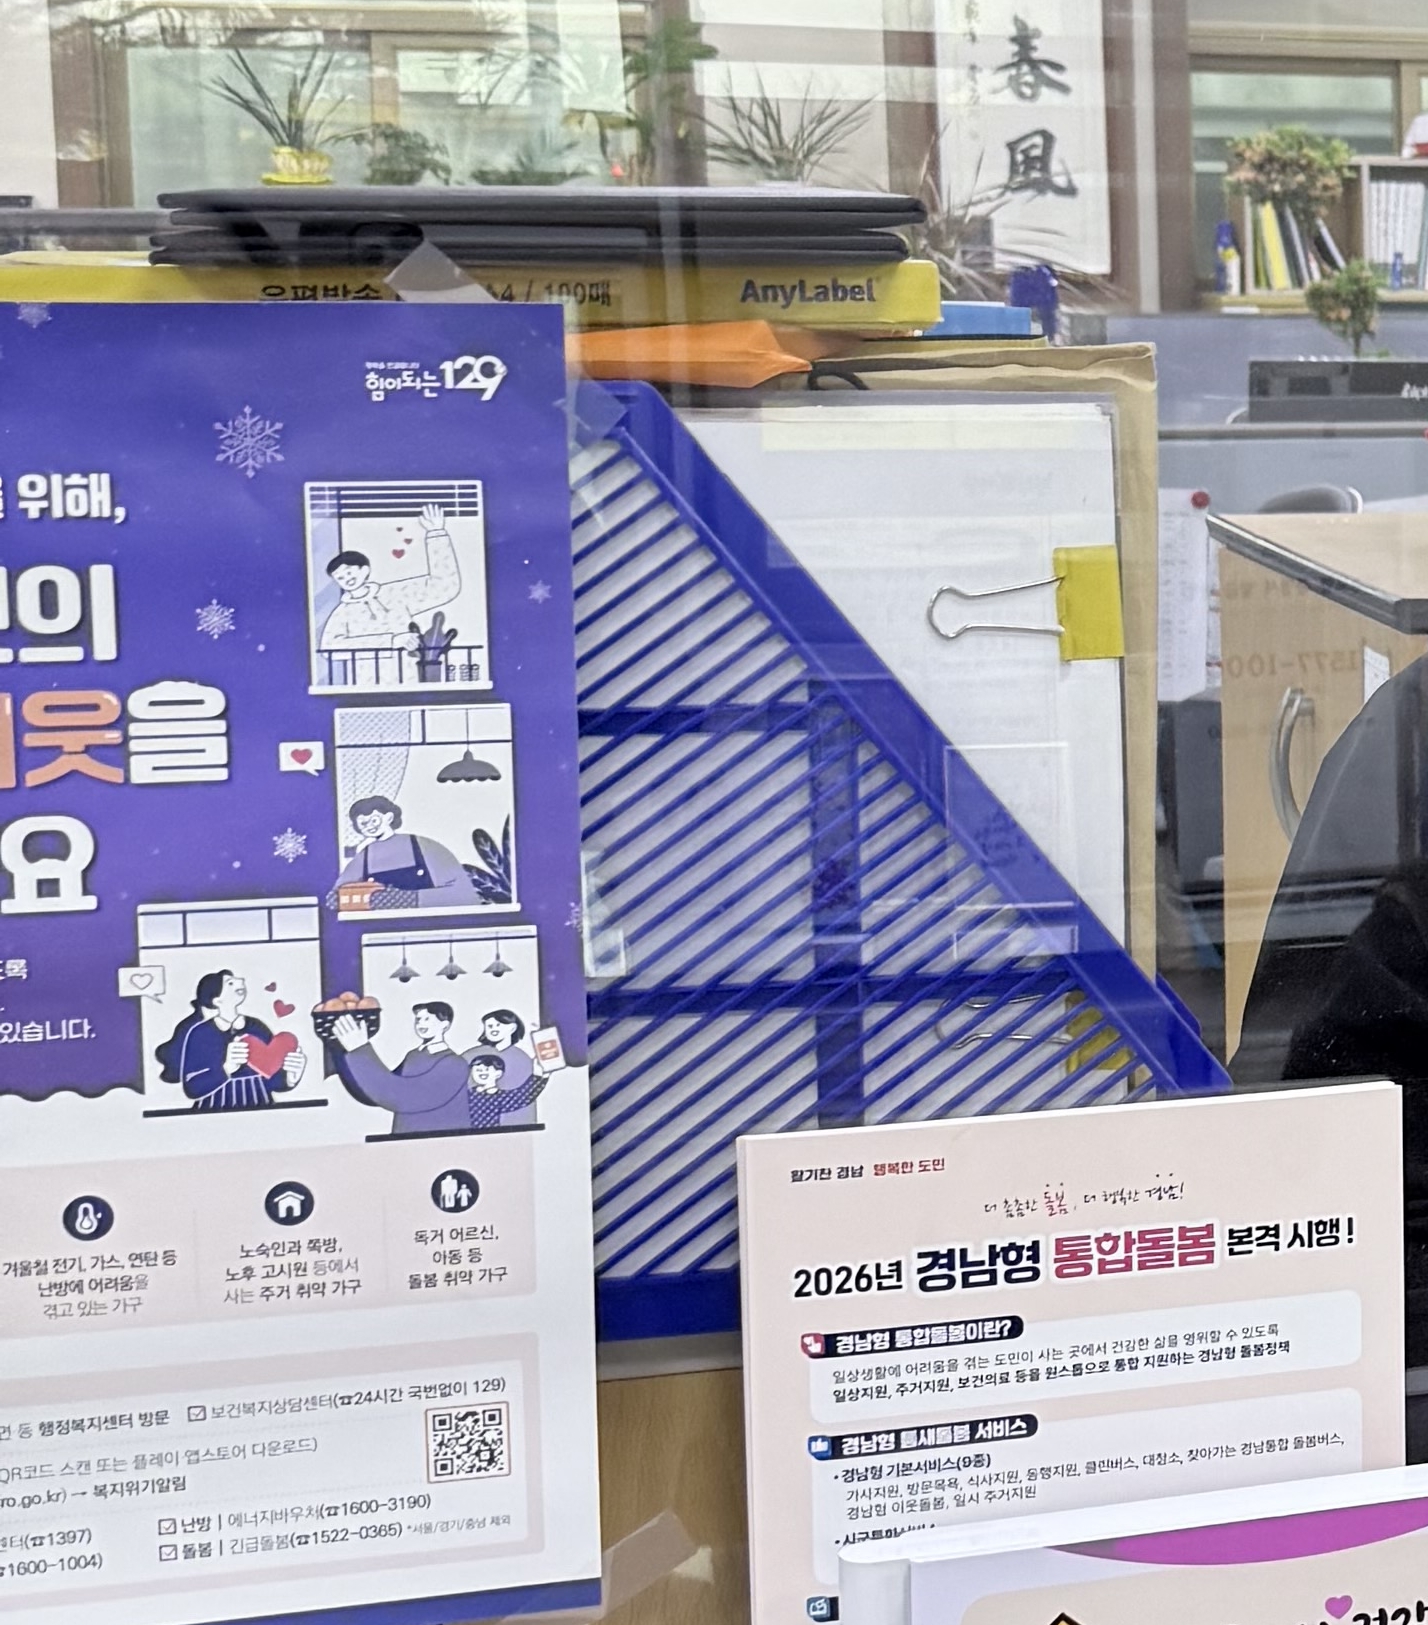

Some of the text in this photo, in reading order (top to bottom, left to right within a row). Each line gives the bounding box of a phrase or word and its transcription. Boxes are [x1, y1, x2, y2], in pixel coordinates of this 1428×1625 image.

[740, 278, 878, 306] AnyLabel
[366, 356, 506, 401] 힘이되는 129
[18, 473, 125, 523] 위해,
[0, 1019, 95, 1043] 있습니다.
[415, 1225, 498, 1245] 독거 어르신,
[795, 1260, 902, 1297] 2026년
[917, 1240, 1040, 1292] 경남형
[1054, 1224, 1215, 1278] 통합돌봄
[1227, 1224, 1279, 1256] 본격
[409, 1267, 507, 1289] 돌봄 취약 가구
[836, 1320, 1011, 1353] 경남형 통합돌봄이란?
[39, 1414, 133, 1436] 행정복지센터
[139, 1410, 169, 1427] 방문
[408, 1382, 467, 1399] 국번없이
[474, 1377, 505, 1392] 129)
[842, 1433, 895, 1455] 경남형
[976, 1419, 1027, 1439] 서비스
[93, 1476, 186, 1499] 복지위기알림
